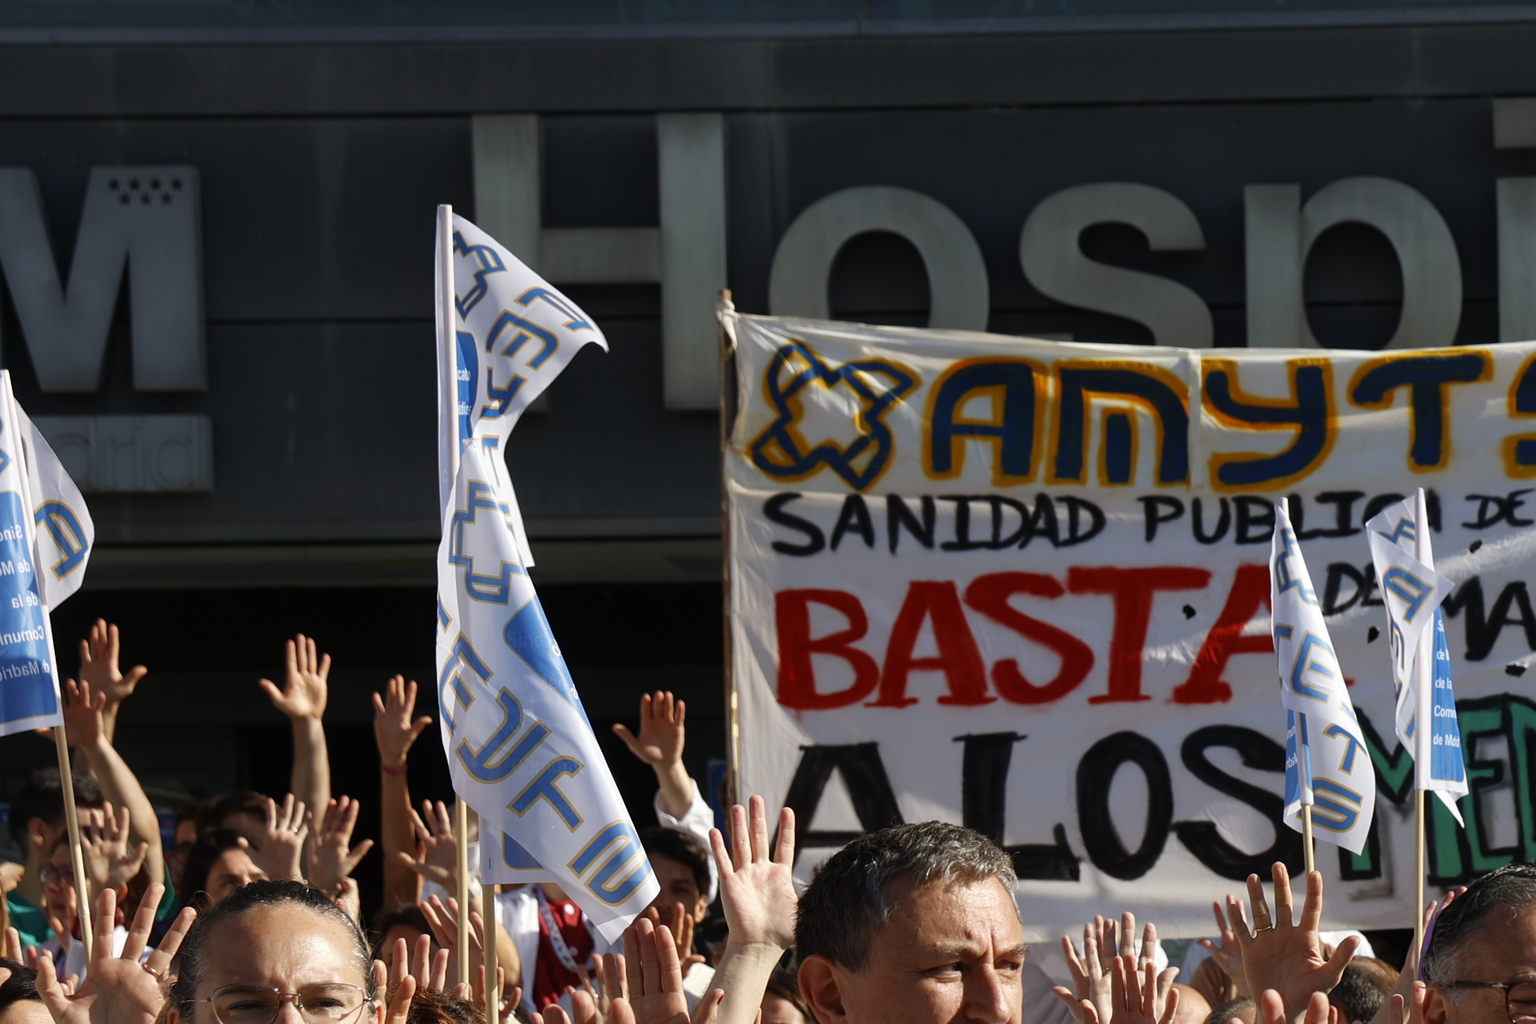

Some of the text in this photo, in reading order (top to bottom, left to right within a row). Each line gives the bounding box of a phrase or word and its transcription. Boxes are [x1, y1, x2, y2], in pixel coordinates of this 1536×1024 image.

[760, 492, 1106, 557] SANIDAD
[1463, 488, 1534, 530] DE
[954, 726, 1308, 882] LOS
